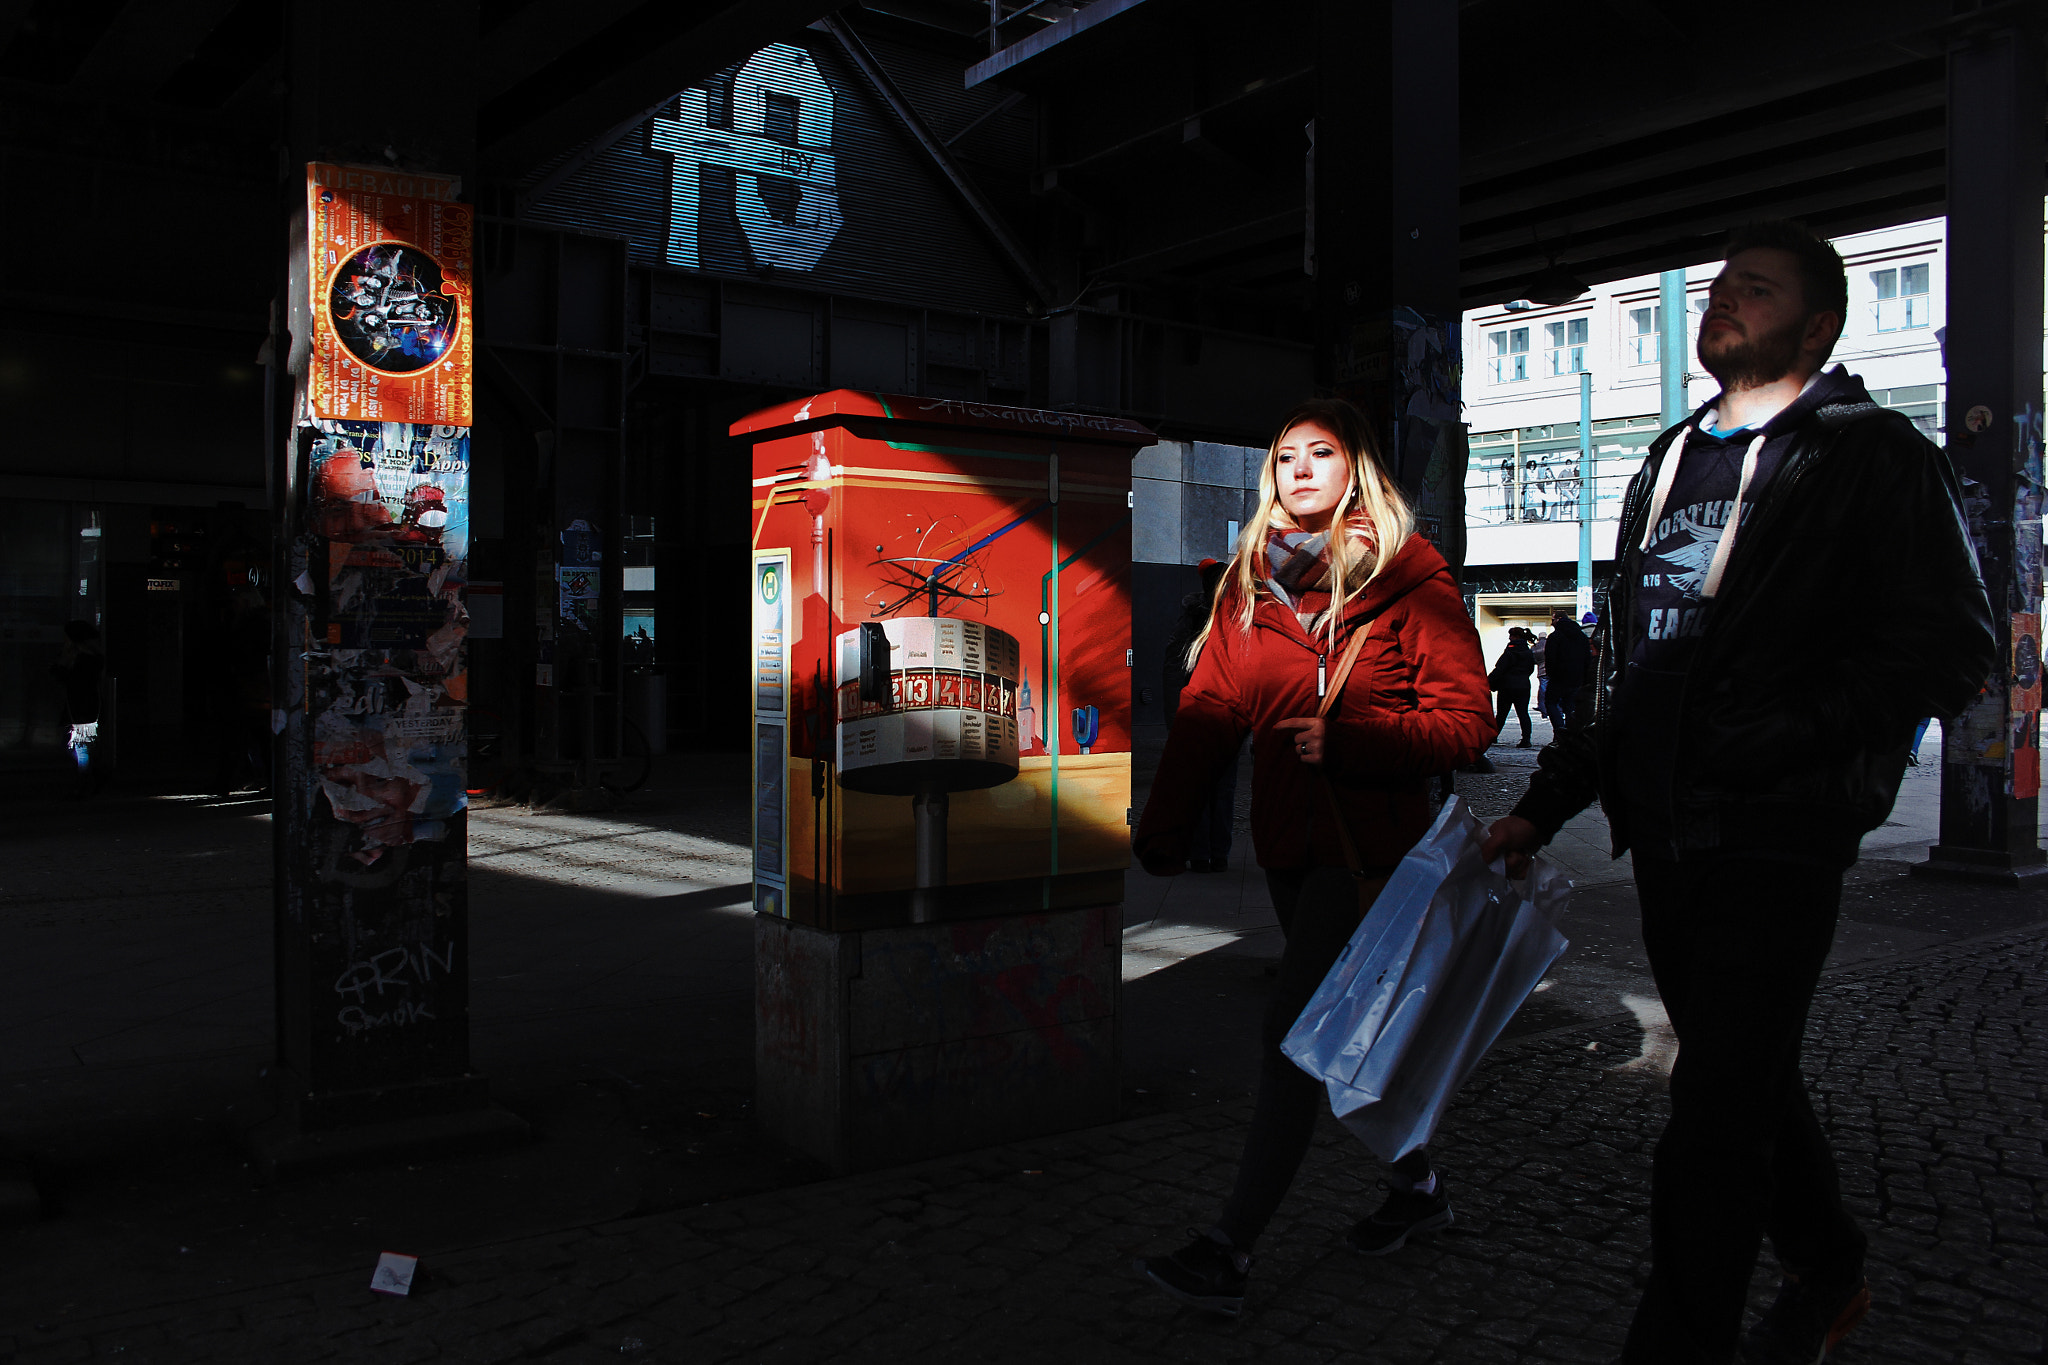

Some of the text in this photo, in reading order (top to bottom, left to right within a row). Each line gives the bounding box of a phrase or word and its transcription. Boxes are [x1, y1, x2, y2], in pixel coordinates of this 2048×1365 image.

[1643, 574, 1661, 588] A76
[906, 679, 928, 703] 13
[934, 679, 955, 705] 14
[959, 680, 980, 704] 15
